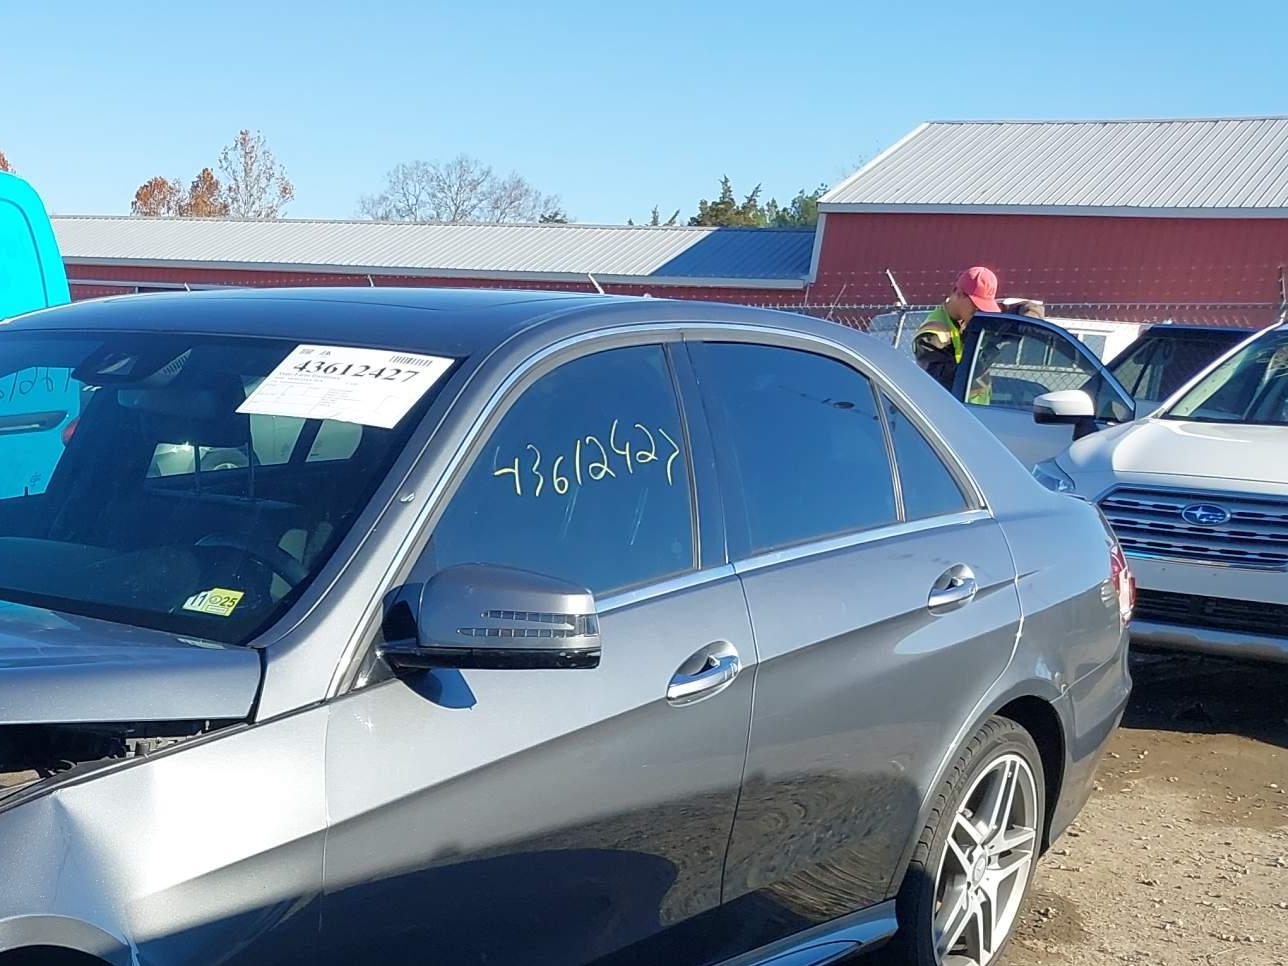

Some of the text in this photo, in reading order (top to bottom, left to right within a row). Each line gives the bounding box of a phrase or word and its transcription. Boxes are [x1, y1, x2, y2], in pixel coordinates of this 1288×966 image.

[293, 359, 421, 383] 43612427
[493, 419, 680, 497] 43612427
[220, 596, 238, 608] 25
